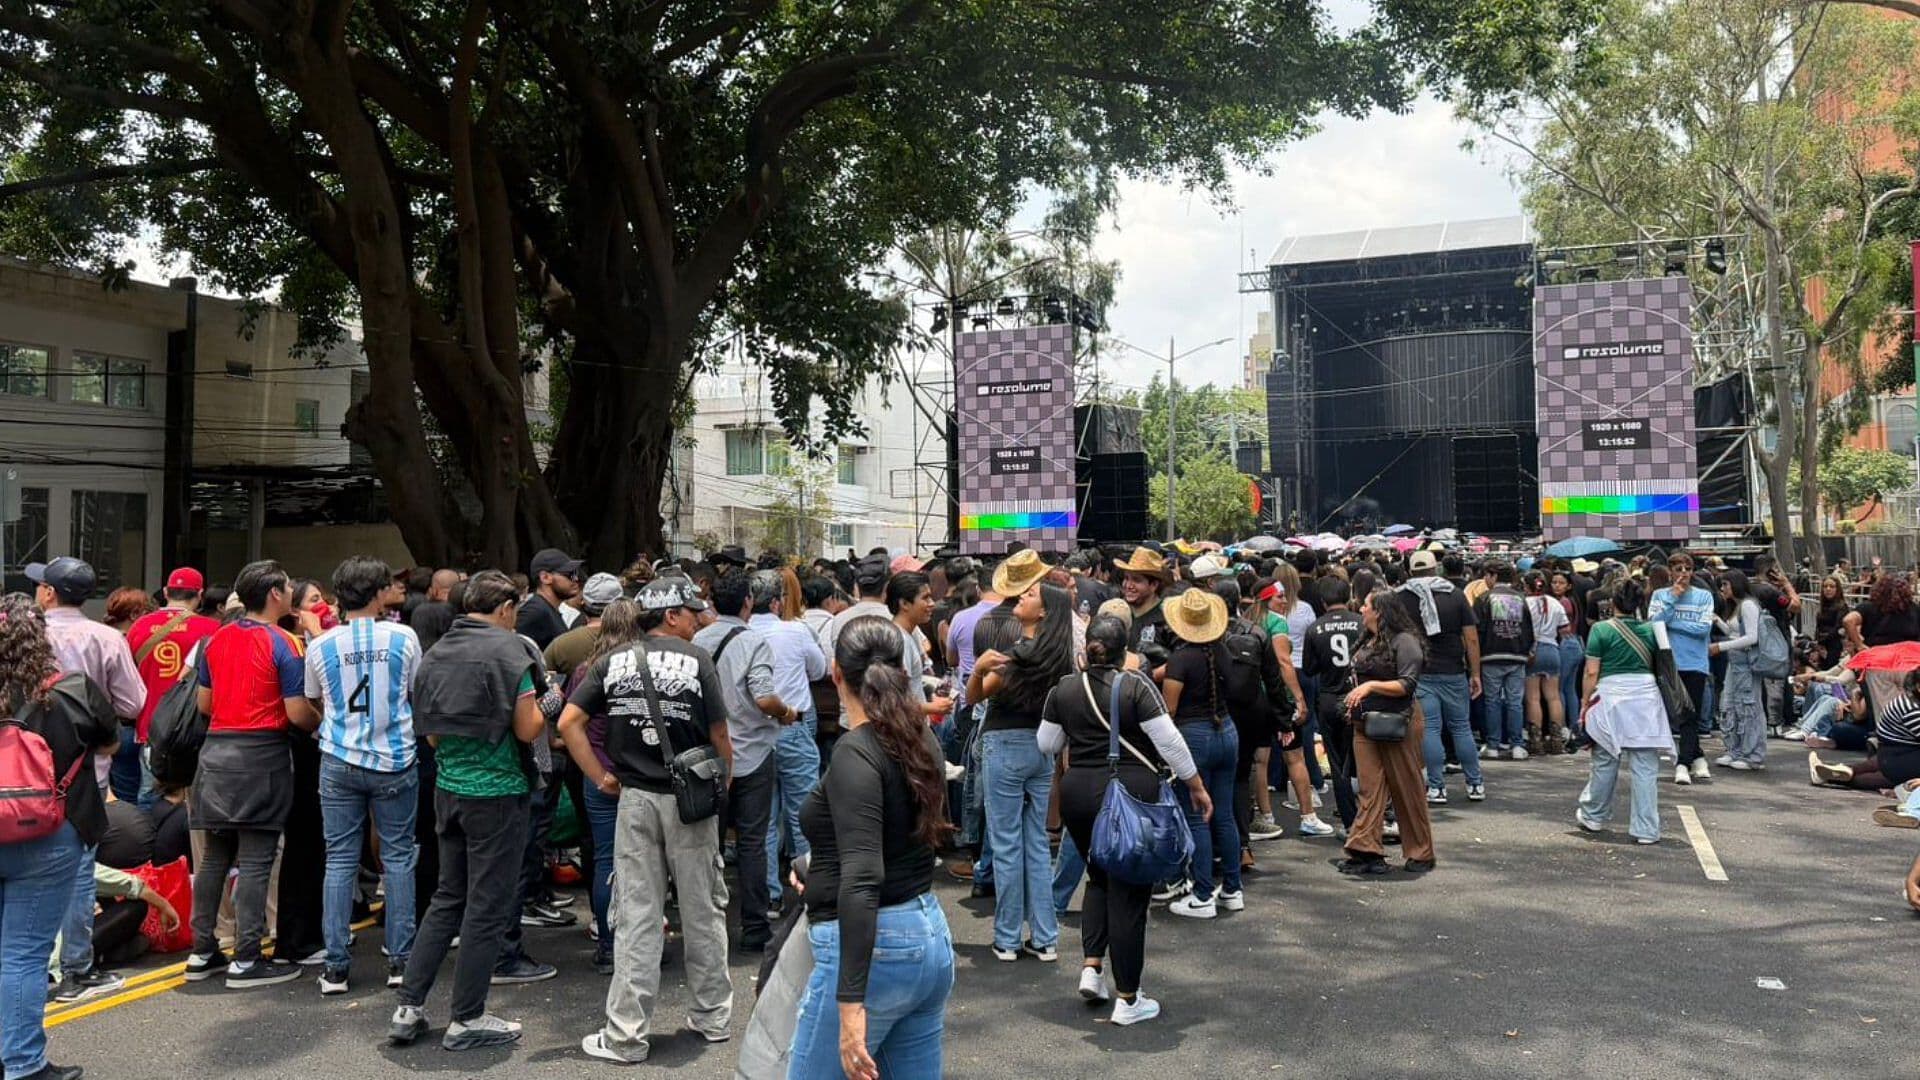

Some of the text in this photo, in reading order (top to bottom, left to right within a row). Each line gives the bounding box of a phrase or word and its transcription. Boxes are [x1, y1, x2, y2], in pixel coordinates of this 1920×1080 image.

[1582, 343, 1662, 357] resolume
[153, 640, 181, 678] 9
[1330, 634, 1350, 667] 9
[348, 673, 370, 718] 4
